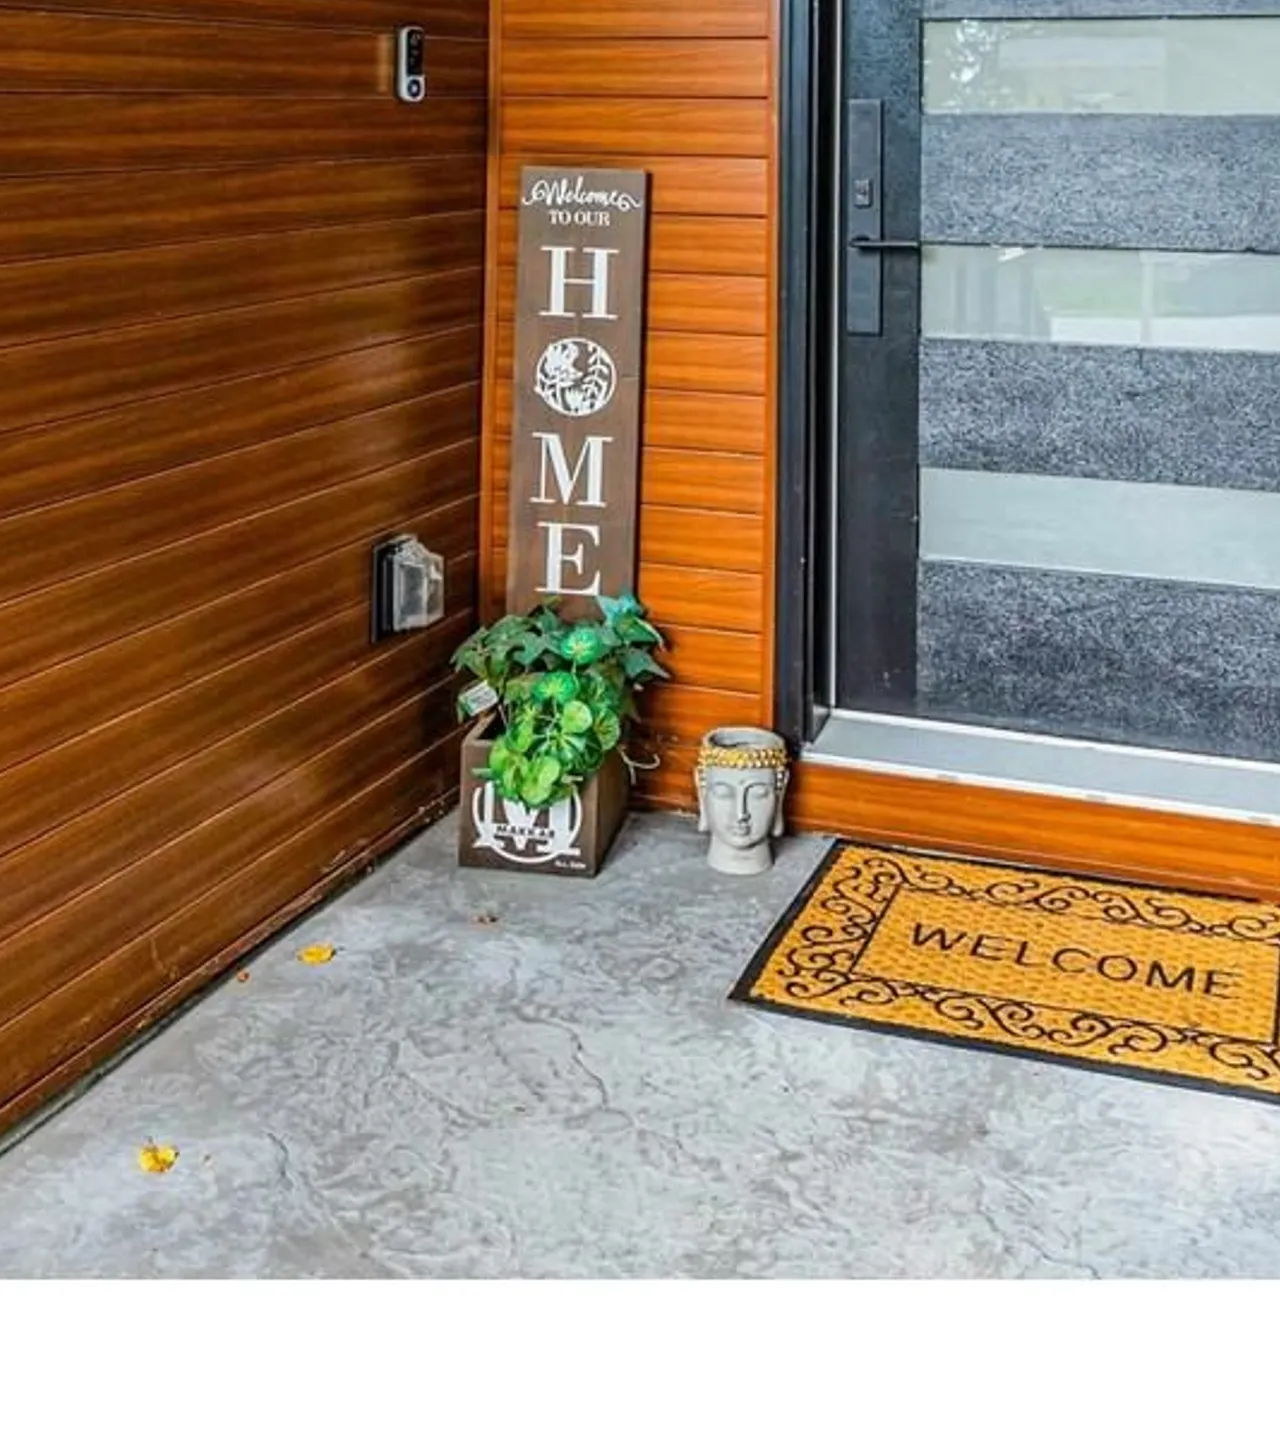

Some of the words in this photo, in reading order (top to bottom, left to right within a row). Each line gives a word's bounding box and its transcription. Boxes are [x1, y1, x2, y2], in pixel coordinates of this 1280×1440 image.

[522, 176, 641, 212] Welcome
[549, 209, 572, 225] TO
[574, 210, 611, 227] OUR
[910, 921, 1240, 1000] WELCOME
